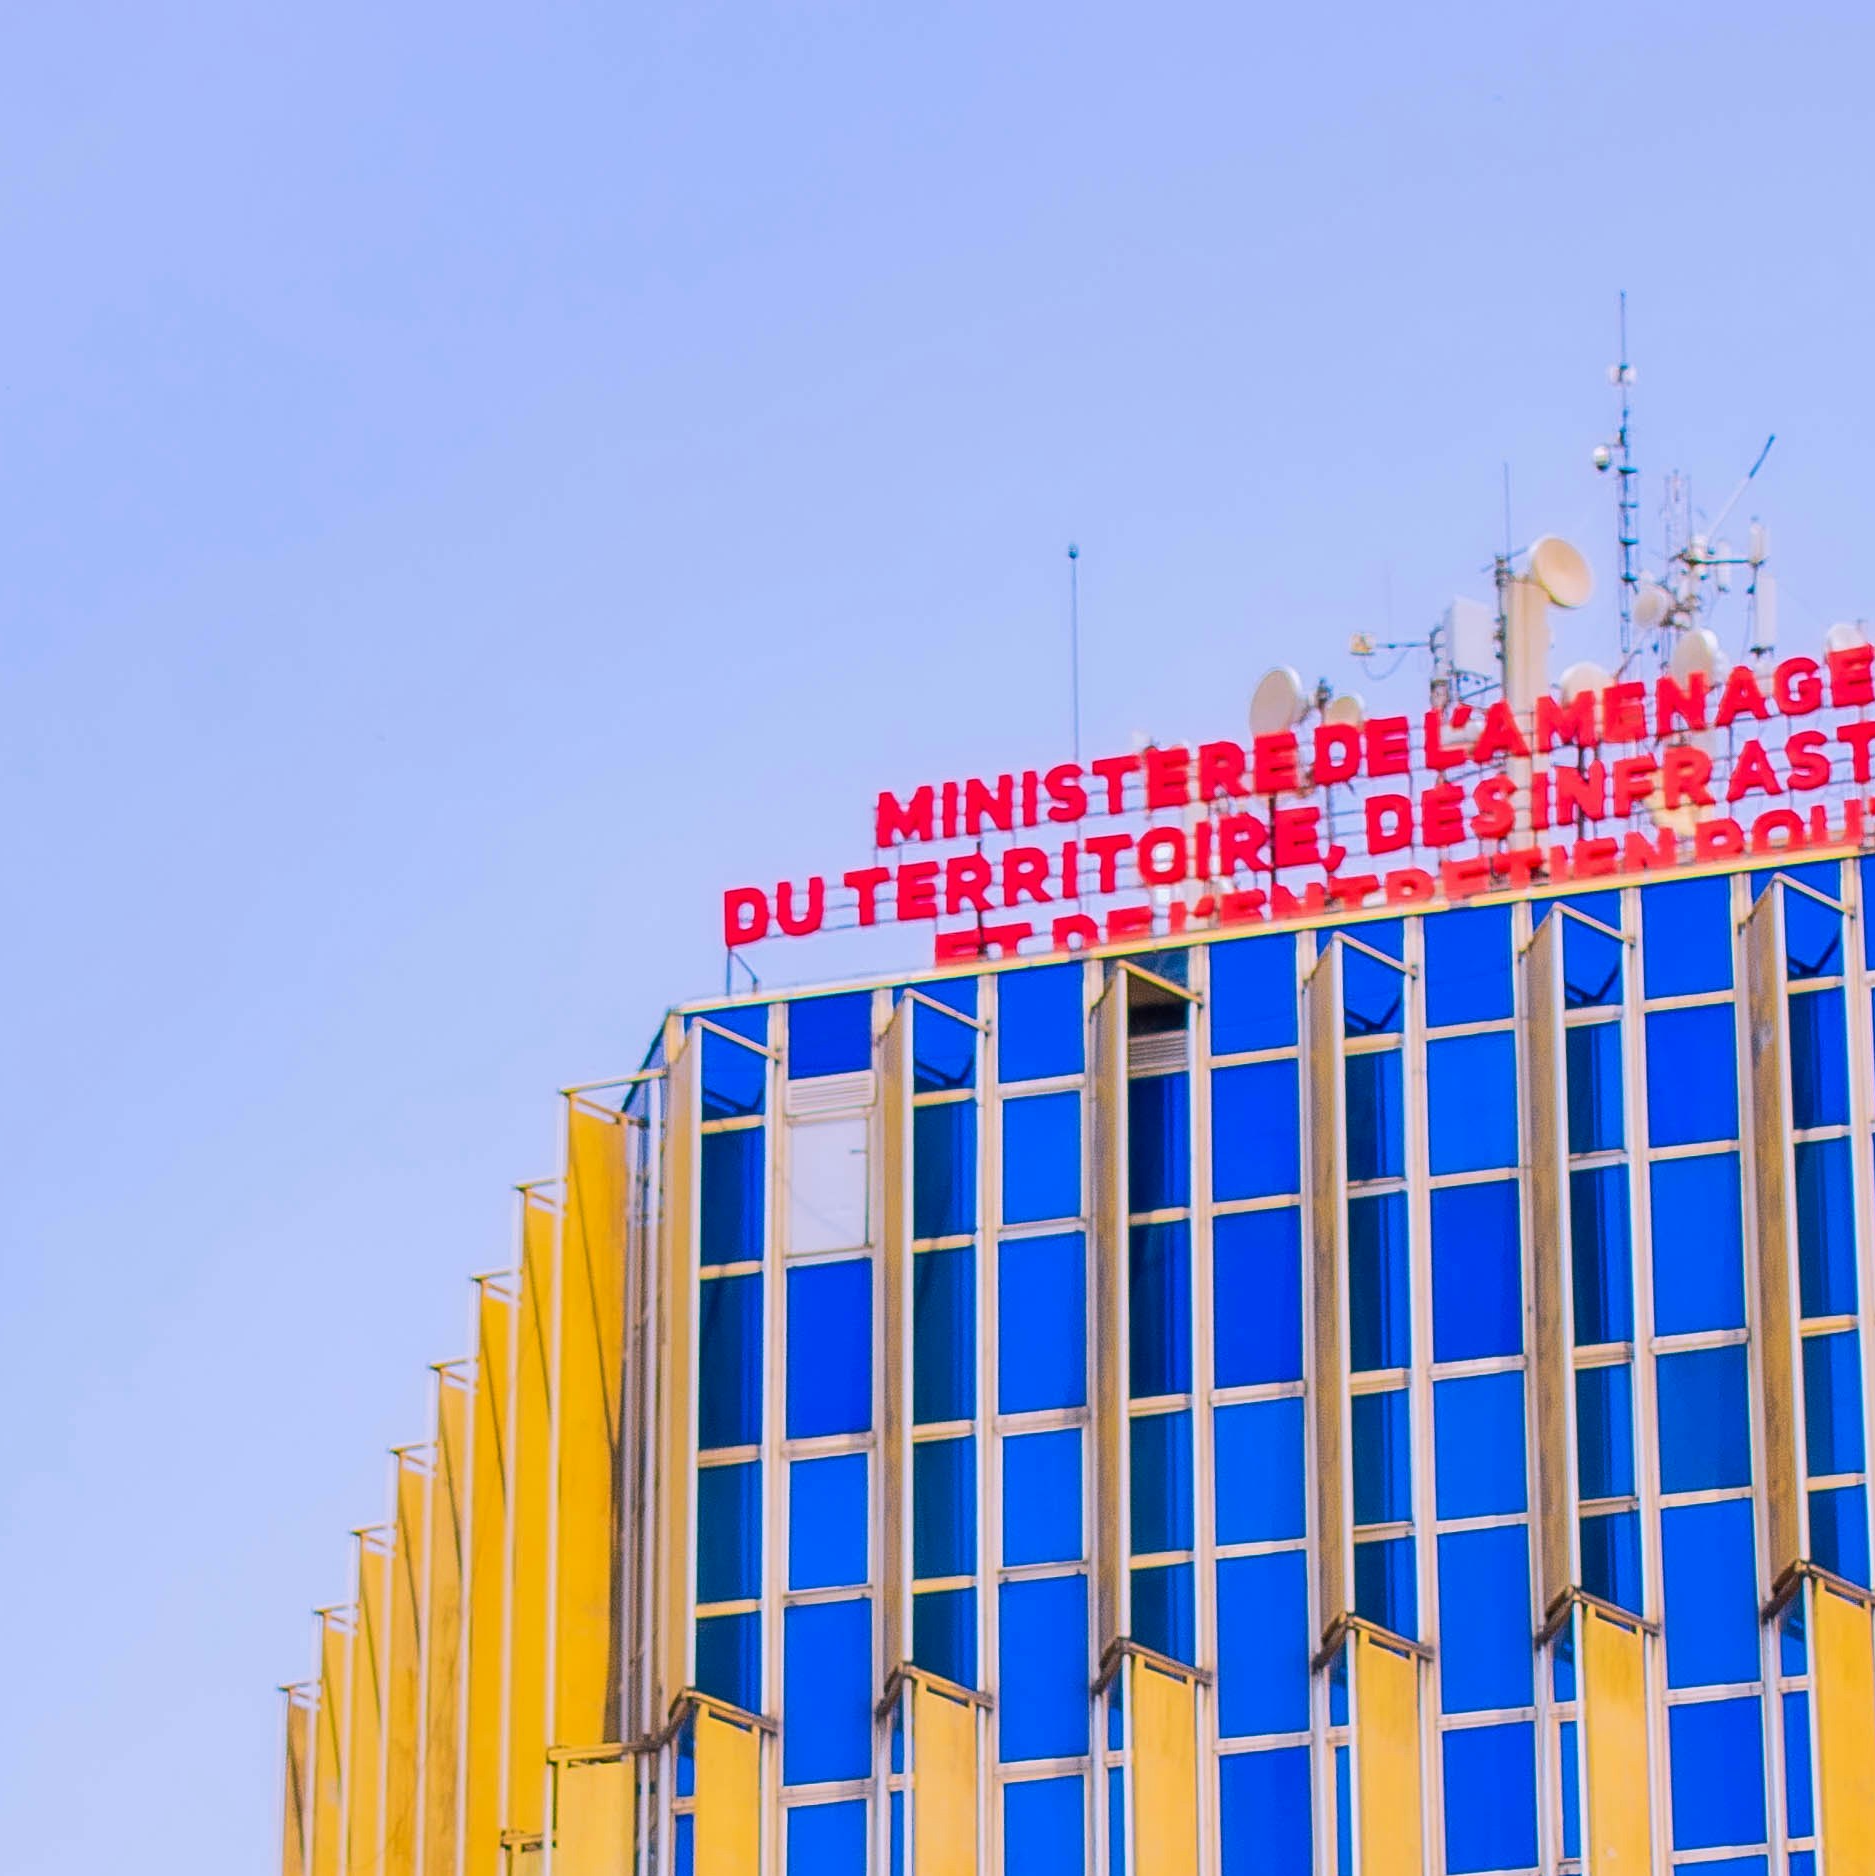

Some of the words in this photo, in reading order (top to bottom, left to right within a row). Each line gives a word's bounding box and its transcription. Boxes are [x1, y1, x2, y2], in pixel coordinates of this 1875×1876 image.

[875, 730, 1300, 847] MINISTERE
[1312, 715, 1410, 785] DE
[724, 876, 824, 948] DU
[843, 805, 1347, 926] TERRITOIRE,
[1364, 774, 1518, 855] DES
